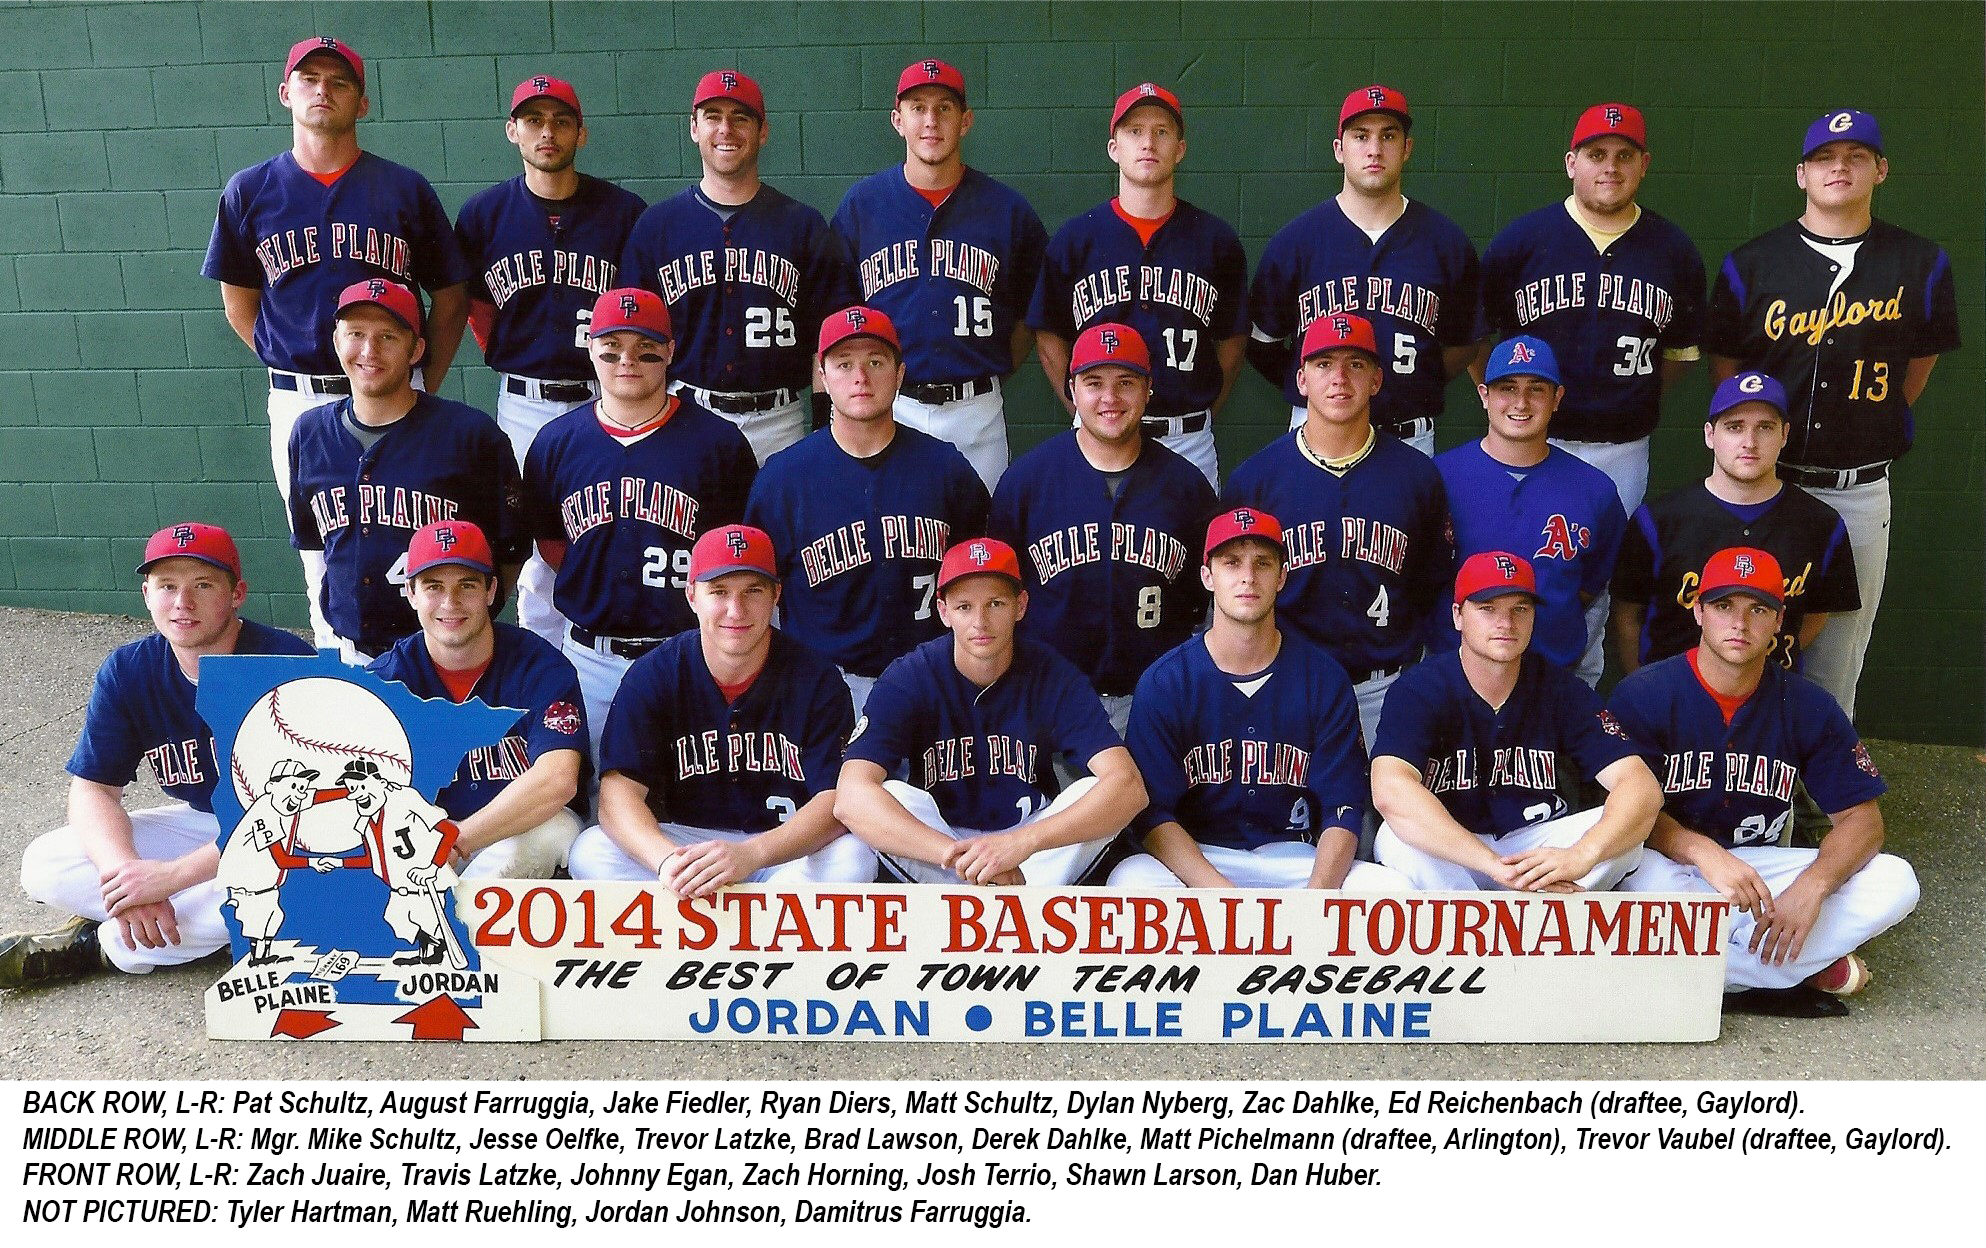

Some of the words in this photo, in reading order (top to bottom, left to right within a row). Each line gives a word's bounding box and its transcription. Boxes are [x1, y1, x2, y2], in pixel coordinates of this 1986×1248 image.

[553, 249, 618, 295] PLAI
[657, 250, 716, 306] ELLE
[724, 248, 800, 307] PLAINE
[860, 239, 919, 301] BELLE
[953, 295, 994, 337] 15
[1139, 266, 1219, 327] PLAINE
[1298, 276, 1360, 332] ELLE
[1515, 272, 1586, 327] BELLE
[1764, 286, 1905, 346] Gaylord
[745, 307, 797, 348] 25
[1161, 327, 1199, 371] 17
[1392, 333, 1418, 375] 5
[1613, 335, 1658, 376] 30
[1848, 359, 1890, 402] 13
[620, 477, 700, 541] PLAINE
[800, 520, 871, 588] BELLE
[1028, 522, 1100, 586] BELLE
[1533, 513, 1591, 561] A's
[642, 546, 692, 588] 29
[913, 573, 936, 621] 7
[1136, 585, 1162, 630] 8
[1366, 584, 1390, 628] 4
[727, 732, 806, 782] PLAIN
[1183, 738, 1233, 789] ELLE
[1241, 739, 1311, 788] PLAIN
[392, 826, 417, 860] J
[474, 887, 662, 950] 2014
[678, 893, 908, 953] STATE
[941, 895, 1292, 957] BASEBALL
[1323, 898, 1730, 958] TOURNAMENT
[217, 970, 280, 1001] BELLE
[331, 957, 351, 975] 169
[402, 973, 498, 996] JORDAN
[553, 958, 642, 989] THE
[666, 960, 794, 991] BEST
[826, 961, 890, 991] OF
[917, 963, 1041, 992] TOWN
[1075, 964, 1200, 994] TEAM
[1237, 964, 1488, 995] BASEBALL
[254, 984, 332, 1013] PLAINE
[689, 998, 930, 1036] JORDAN
[1025, 1001, 1183, 1038] BELLE
[1223, 1002, 1432, 1039] PLAINE
